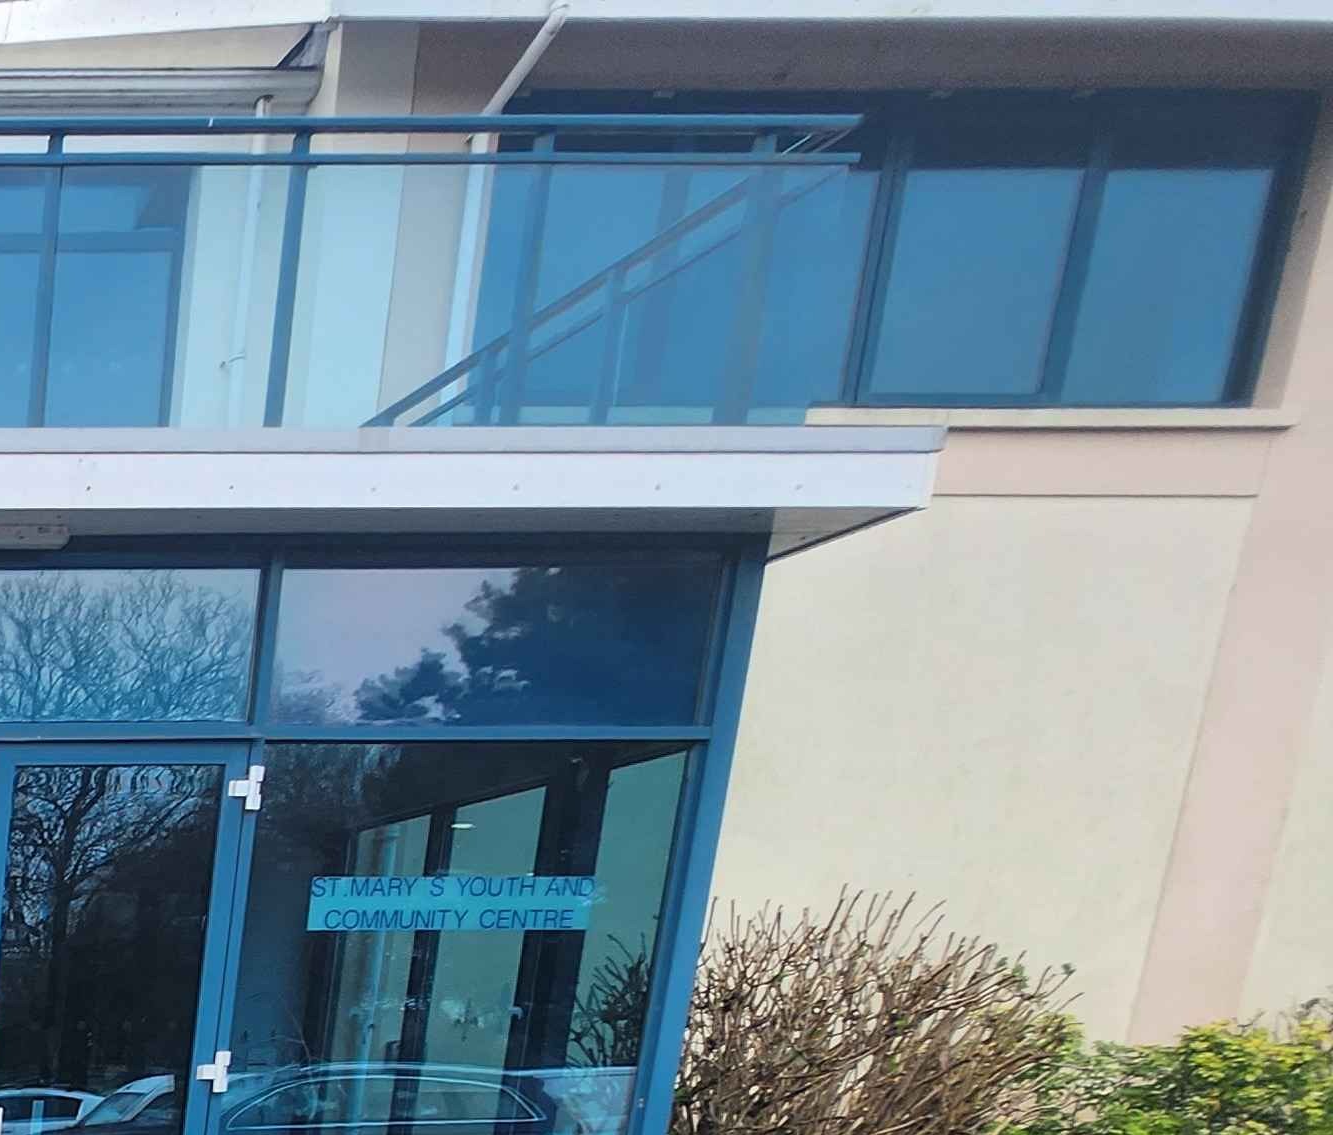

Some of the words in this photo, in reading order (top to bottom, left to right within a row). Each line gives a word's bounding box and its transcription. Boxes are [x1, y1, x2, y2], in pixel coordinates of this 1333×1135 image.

[458, 876, 535, 897] YOUTH
[545, 877, 596, 897] AND
[324, 909, 469, 929] COMMUNITY
[478, 909, 575, 929] CENTRE
